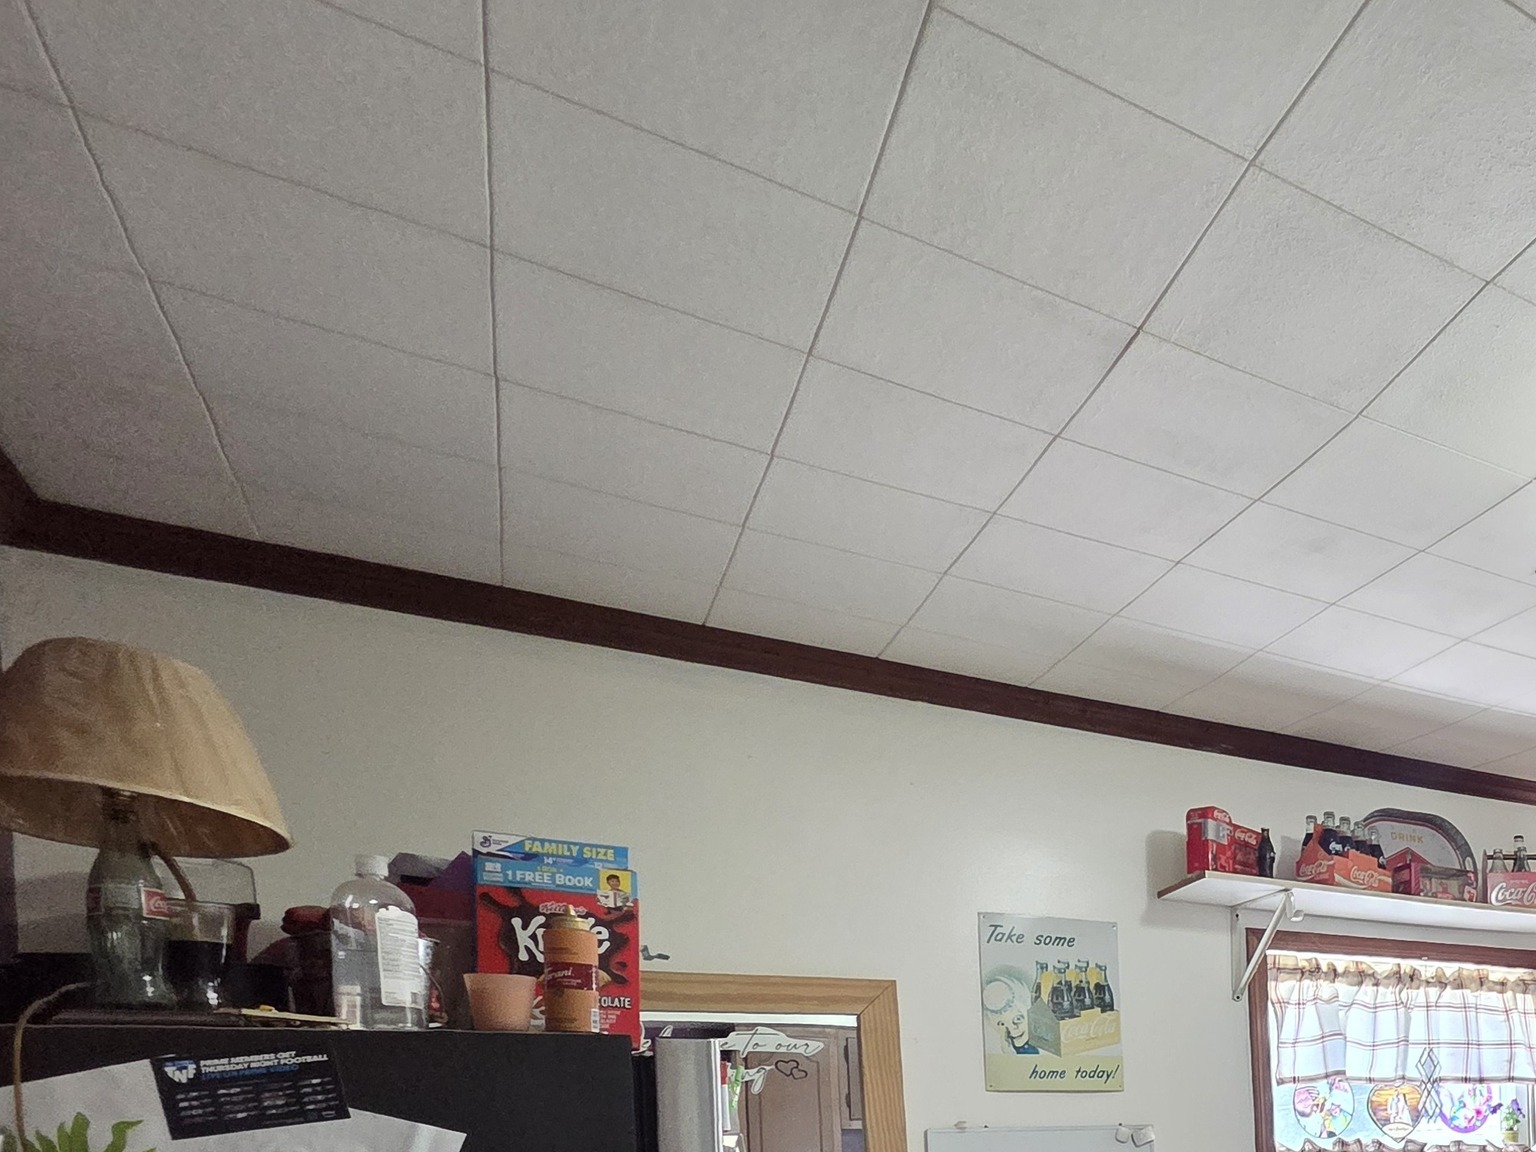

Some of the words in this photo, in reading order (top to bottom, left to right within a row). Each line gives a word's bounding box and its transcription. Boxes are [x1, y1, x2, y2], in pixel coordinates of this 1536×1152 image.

[1390, 831, 1424, 844] DRINK
[524, 839, 580, 858] FAMILY
[583, 846, 615, 861] SIZE
[506, 870, 513, 881] 1
[516, 870, 552, 884] FREE
[555, 873, 593, 887] BOOK
[986, 924, 1025, 944] Take
[1034, 934, 1076, 948] some
[201, 1063, 249, 1073] THURSDAY
[280, 1054, 328, 1065] FOOTBALL
[1029, 1064, 1066, 1080] home
[1075, 1064, 1120, 1084] today!
